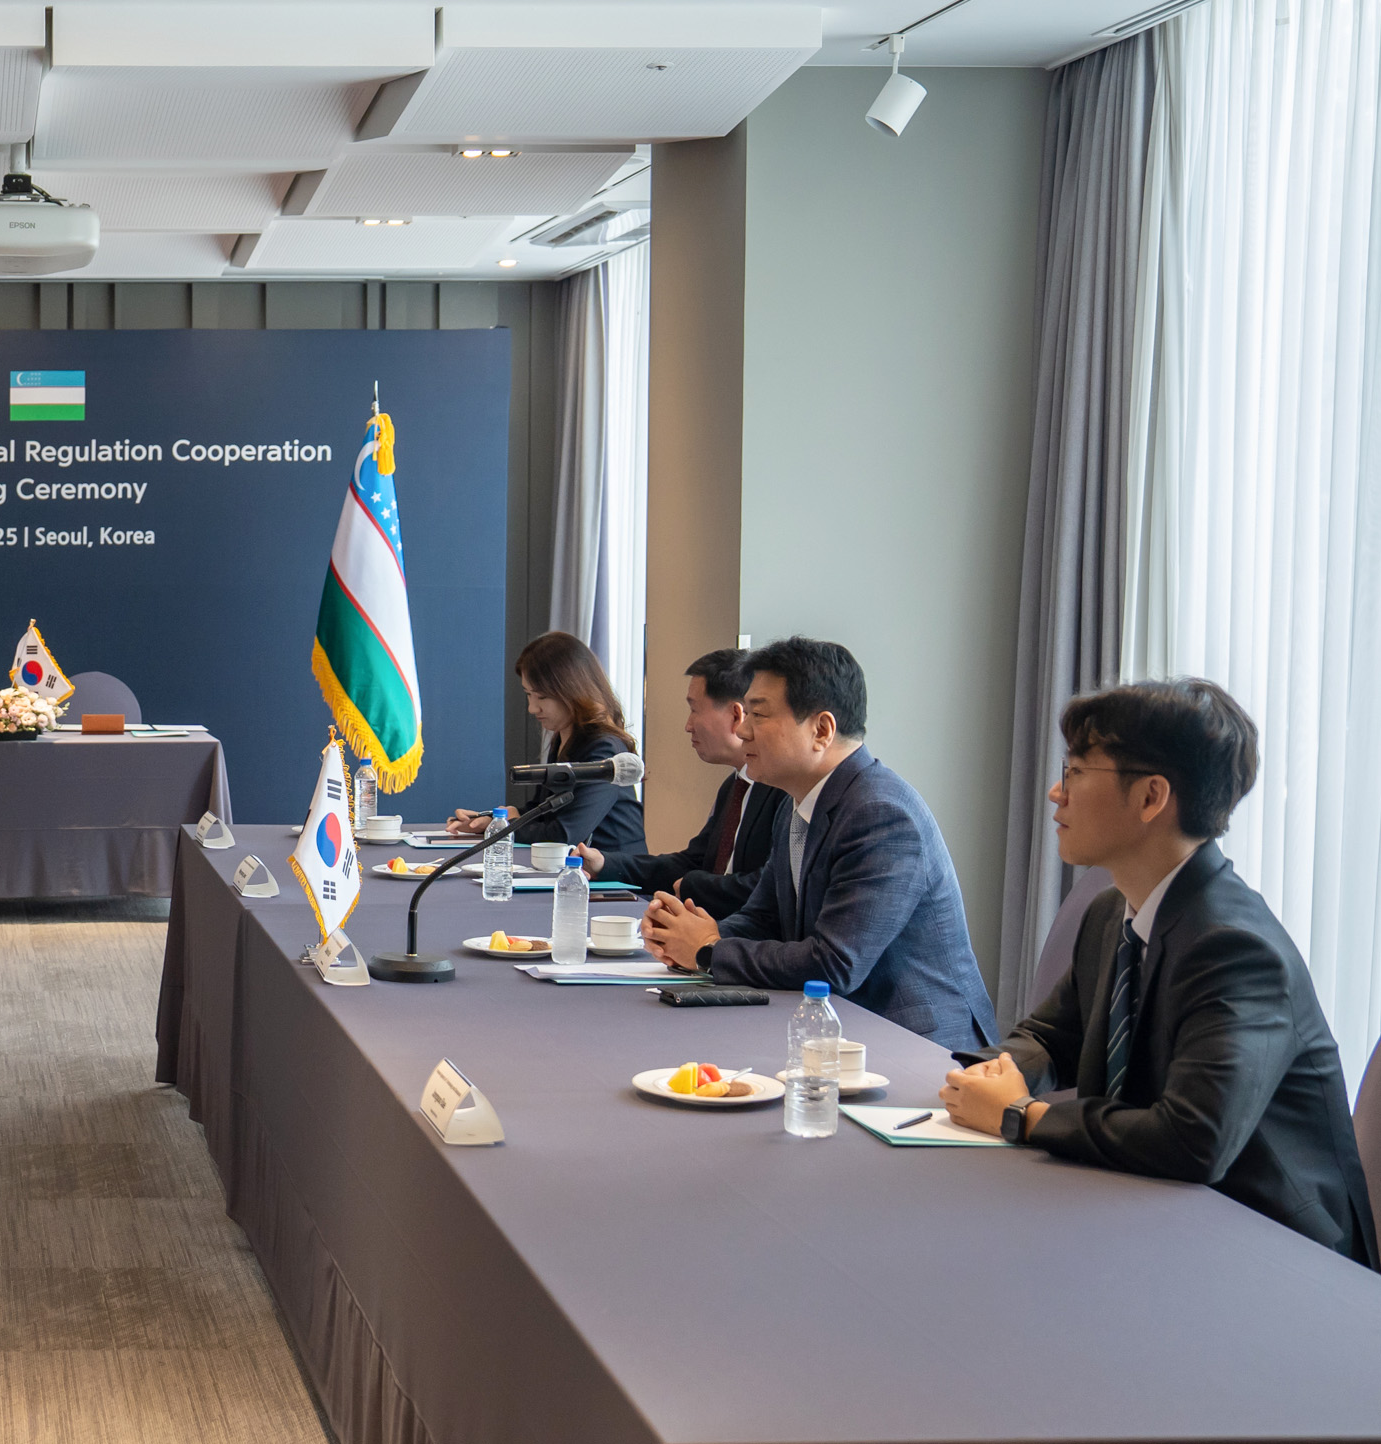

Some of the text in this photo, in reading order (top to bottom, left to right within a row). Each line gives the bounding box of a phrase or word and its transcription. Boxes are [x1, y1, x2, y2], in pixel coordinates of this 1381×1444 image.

[25, 438, 163, 468] Regulation
[171, 438, 333, 467] Cooperation
[16, 477, 148, 504] Ceremony
[35, 525, 94, 548] Seoul,
[99, 526, 156, 546] Korea
